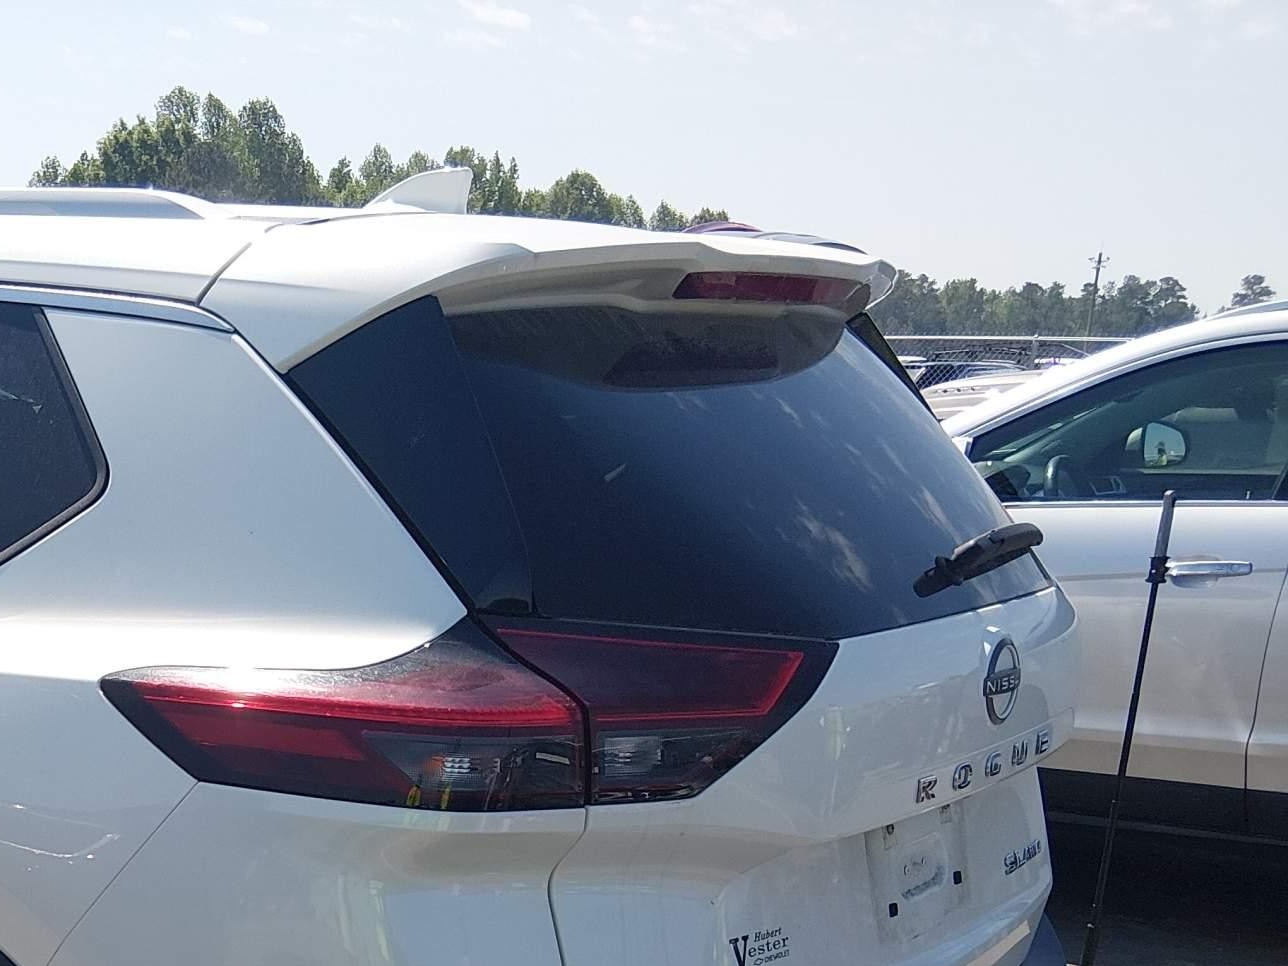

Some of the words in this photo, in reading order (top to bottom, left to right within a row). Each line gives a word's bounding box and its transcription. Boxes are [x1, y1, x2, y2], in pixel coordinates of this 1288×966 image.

[986, 674, 1020, 694] NISS
[915, 730, 1049, 803] ROGUE
[753, 926, 782, 943] Hubert
